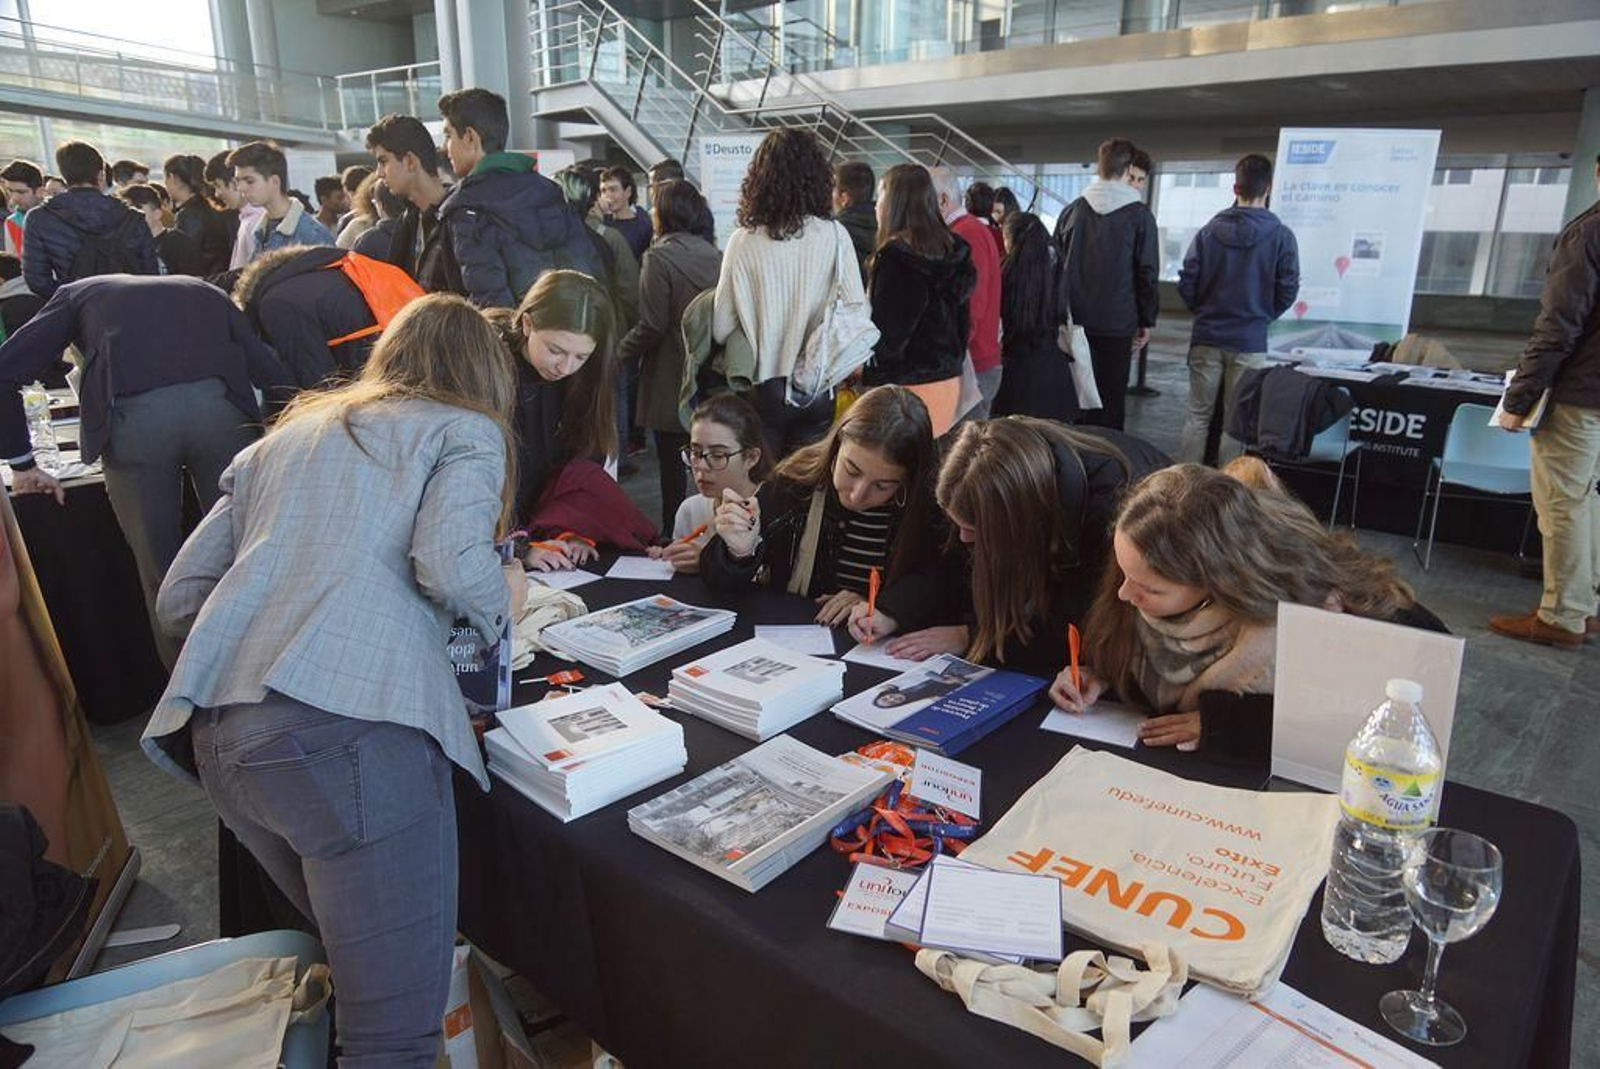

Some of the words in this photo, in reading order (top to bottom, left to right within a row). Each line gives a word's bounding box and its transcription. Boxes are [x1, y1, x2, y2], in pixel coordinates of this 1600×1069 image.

[713, 143, 752, 154] Deusto
[1291, 143, 1326, 154] IESIDE
[1284, 181, 1297, 191] La
[1299, 181, 1331, 192] clave
[1333, 184, 1348, 192] es
[1350, 183, 1400, 193] conocer
[1281, 193, 1292, 201] el
[1295, 192, 1340, 202] camino
[1373, 443, 1420, 458] INSTITUTE
[1379, 794, 1410, 811] AGUA
[1108, 786, 1262, 841] www.cunef.edu
[1130, 849, 1265, 907] Excelencia,
[1186, 852, 1273, 892] Futuro,
[1007, 847, 1246, 941] CUNEF
